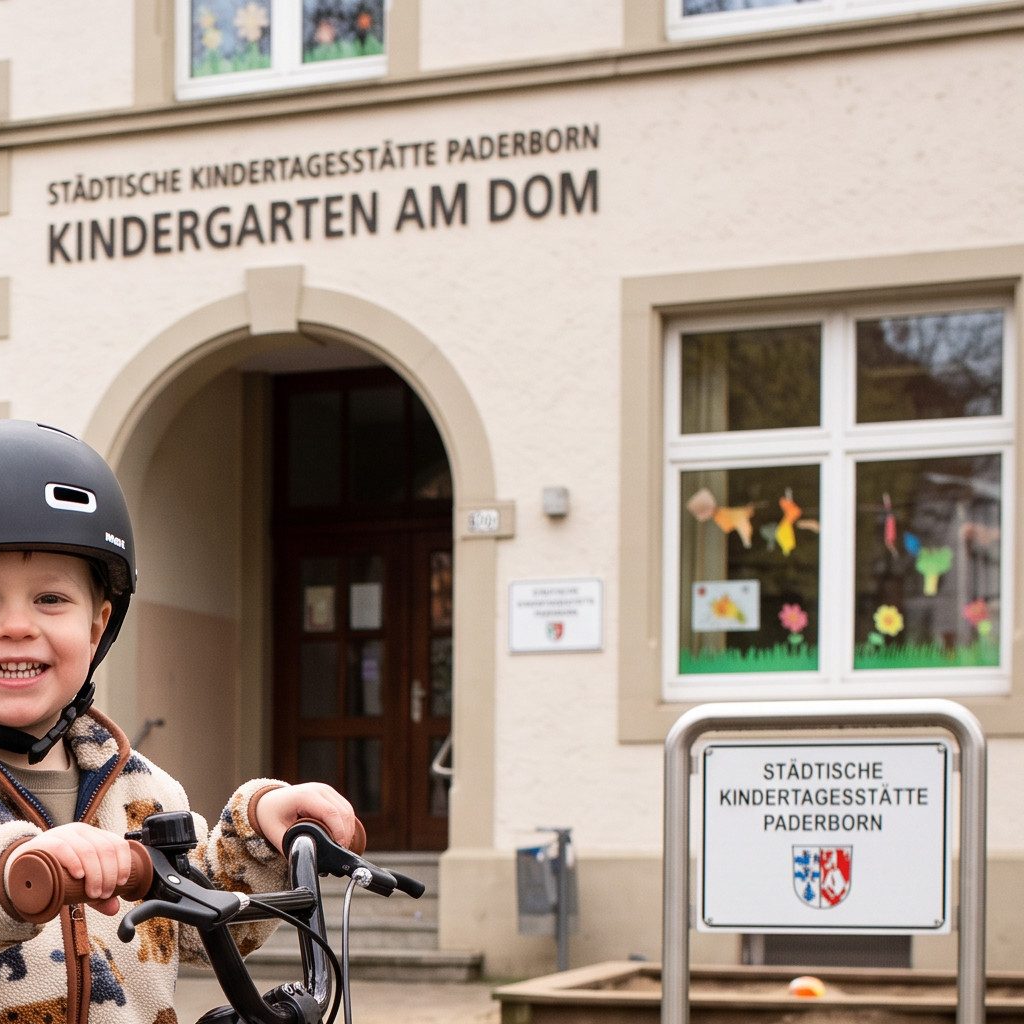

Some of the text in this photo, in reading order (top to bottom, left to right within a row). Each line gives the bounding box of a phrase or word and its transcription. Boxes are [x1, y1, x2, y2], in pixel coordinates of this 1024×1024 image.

[48, 124, 600, 205] STÄDTISCHE KINDERTAGESSTÄTTE PADERBORN
[48, 168, 600, 264] KINDERGARTEN AM DOM
[763, 758, 884, 780] STÄDTISCHE
[719, 783, 929, 806] KINDERTAGESSTÄTTE
[763, 814, 883, 832] PADERBORN
